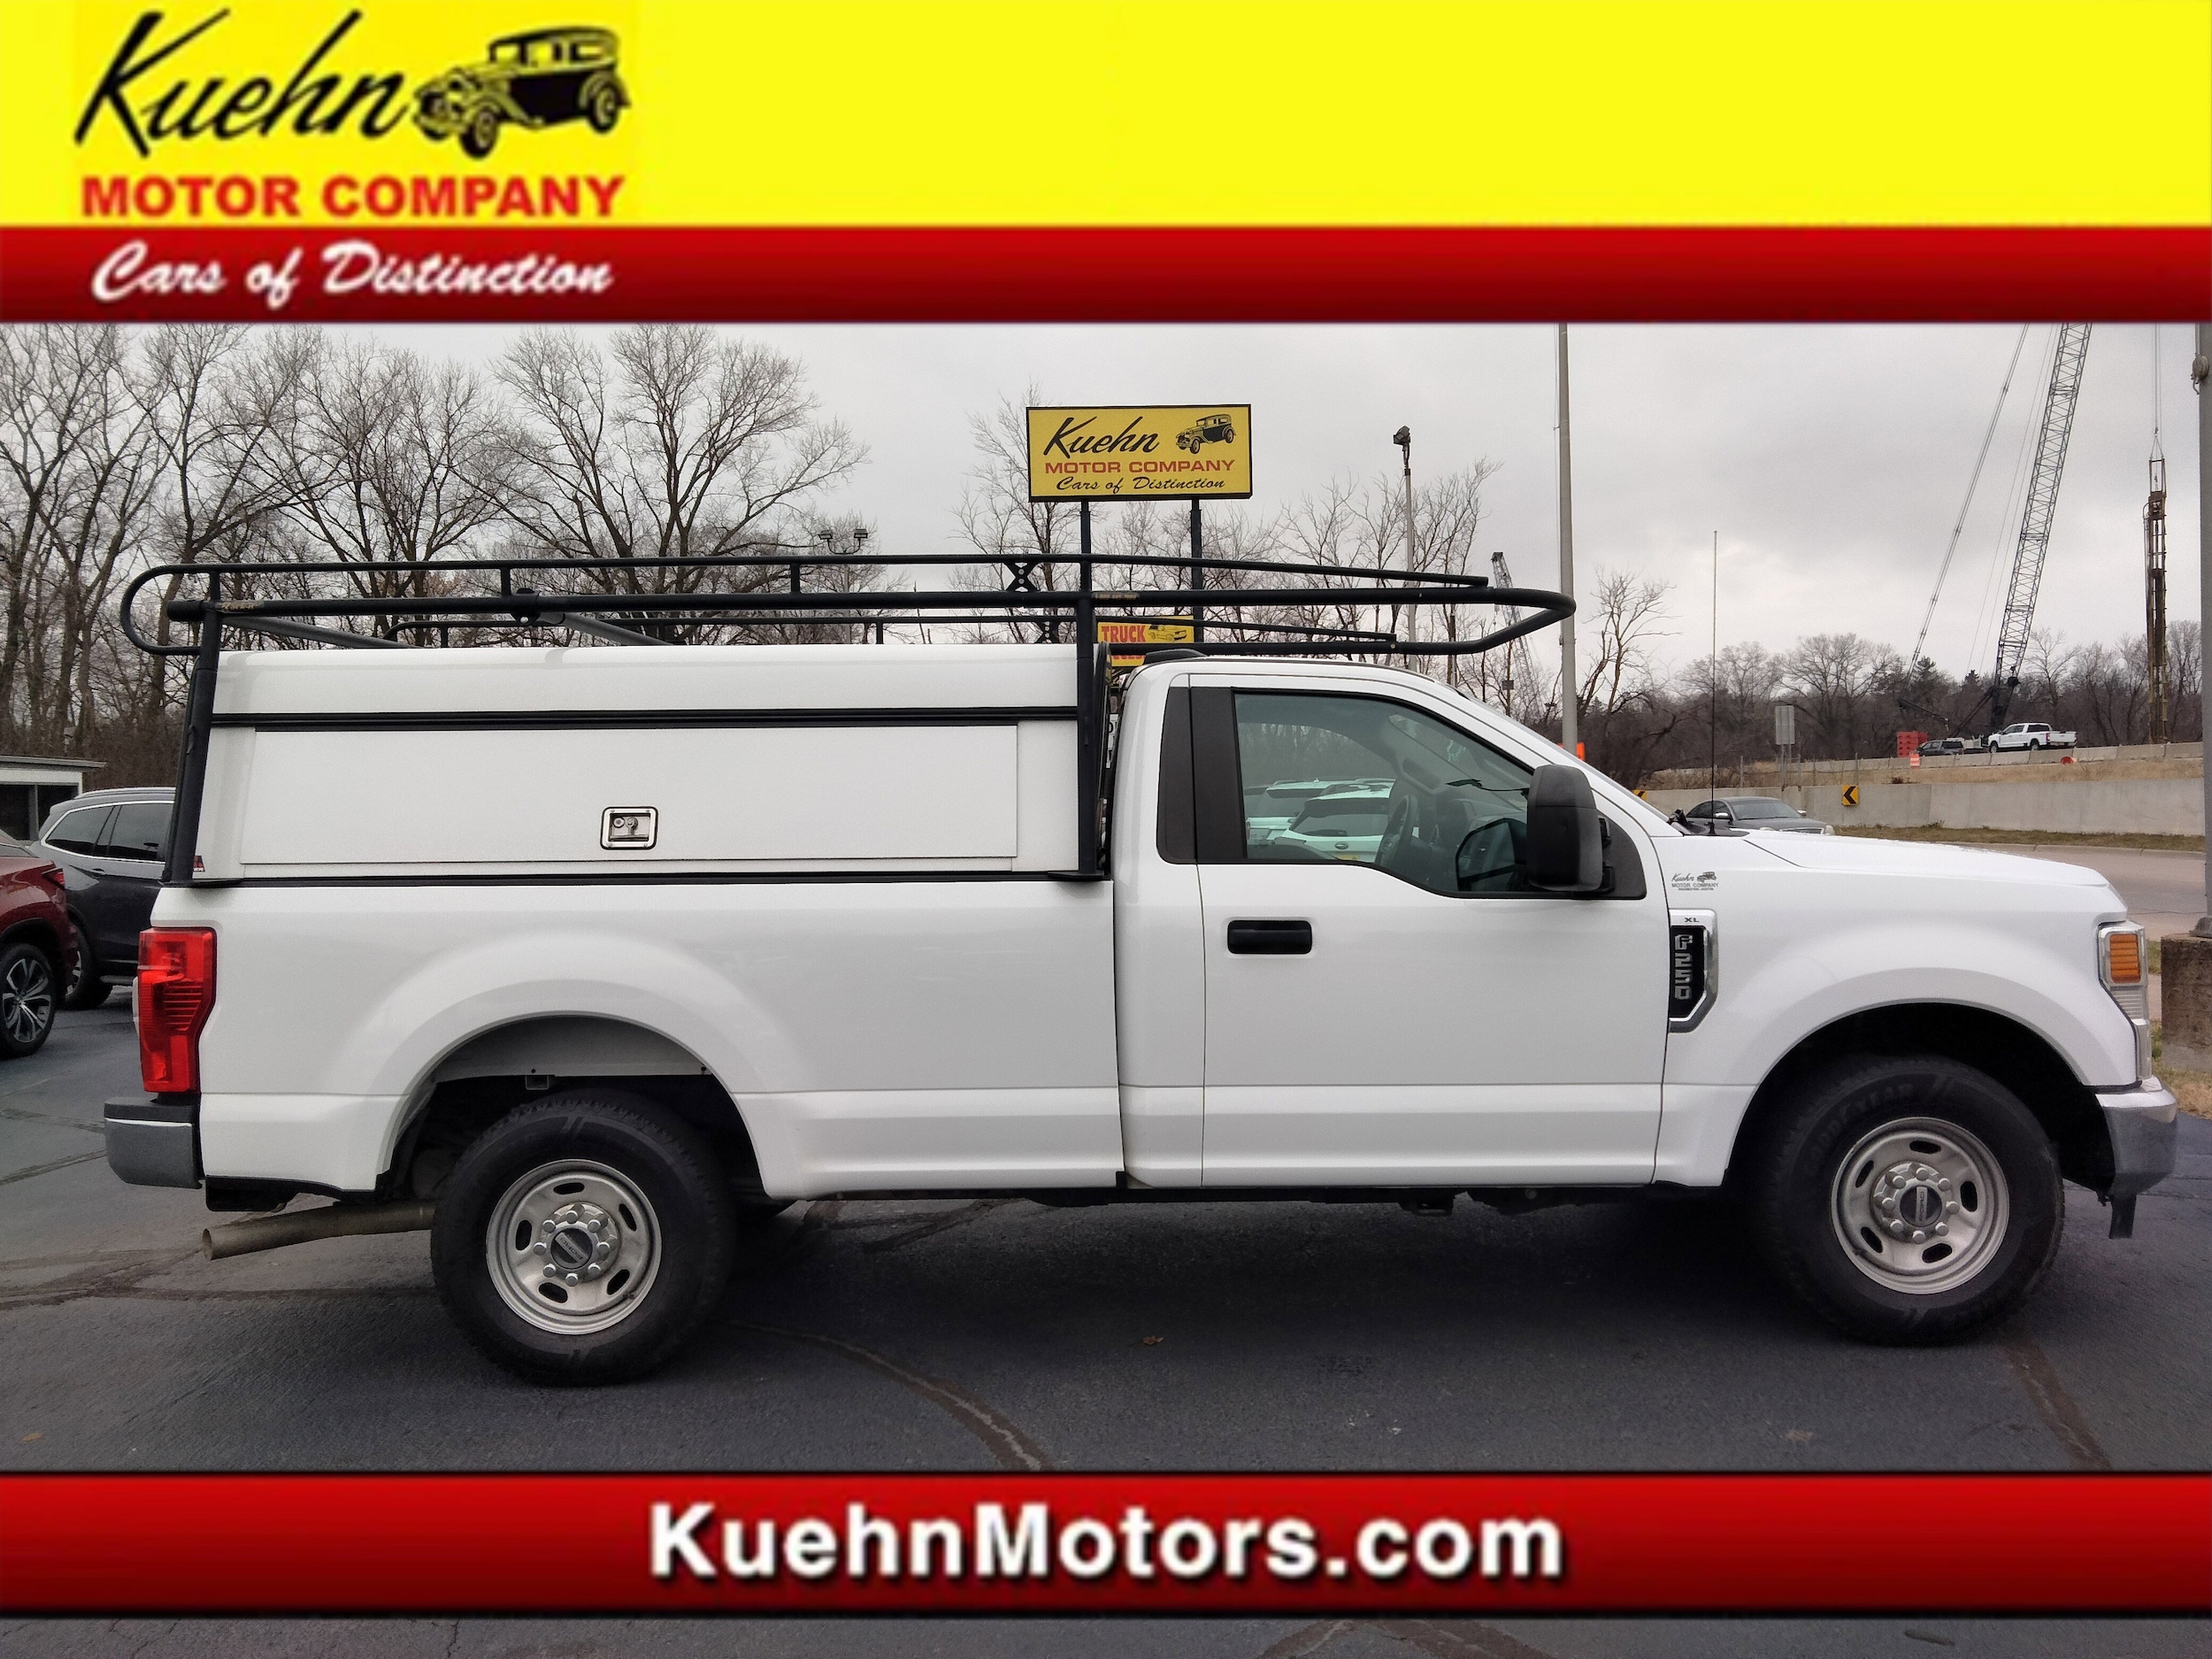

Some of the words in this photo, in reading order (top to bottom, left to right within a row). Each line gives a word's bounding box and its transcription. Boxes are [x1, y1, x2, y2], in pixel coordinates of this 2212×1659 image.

[1043, 416, 1160, 458] Kuehn
[1045, 462, 1121, 473] MOTOR
[1129, 459, 1235, 473] COMPANY
[1056, 476, 1100, 490] Cars
[1105, 478, 1123, 494] of
[1133, 476, 1225, 490] Distinction
[1101, 626, 1146, 642] TRUCK
[1671, 872, 1694, 882] Kuehn
[559, 1236, 584, 1261] FORD
